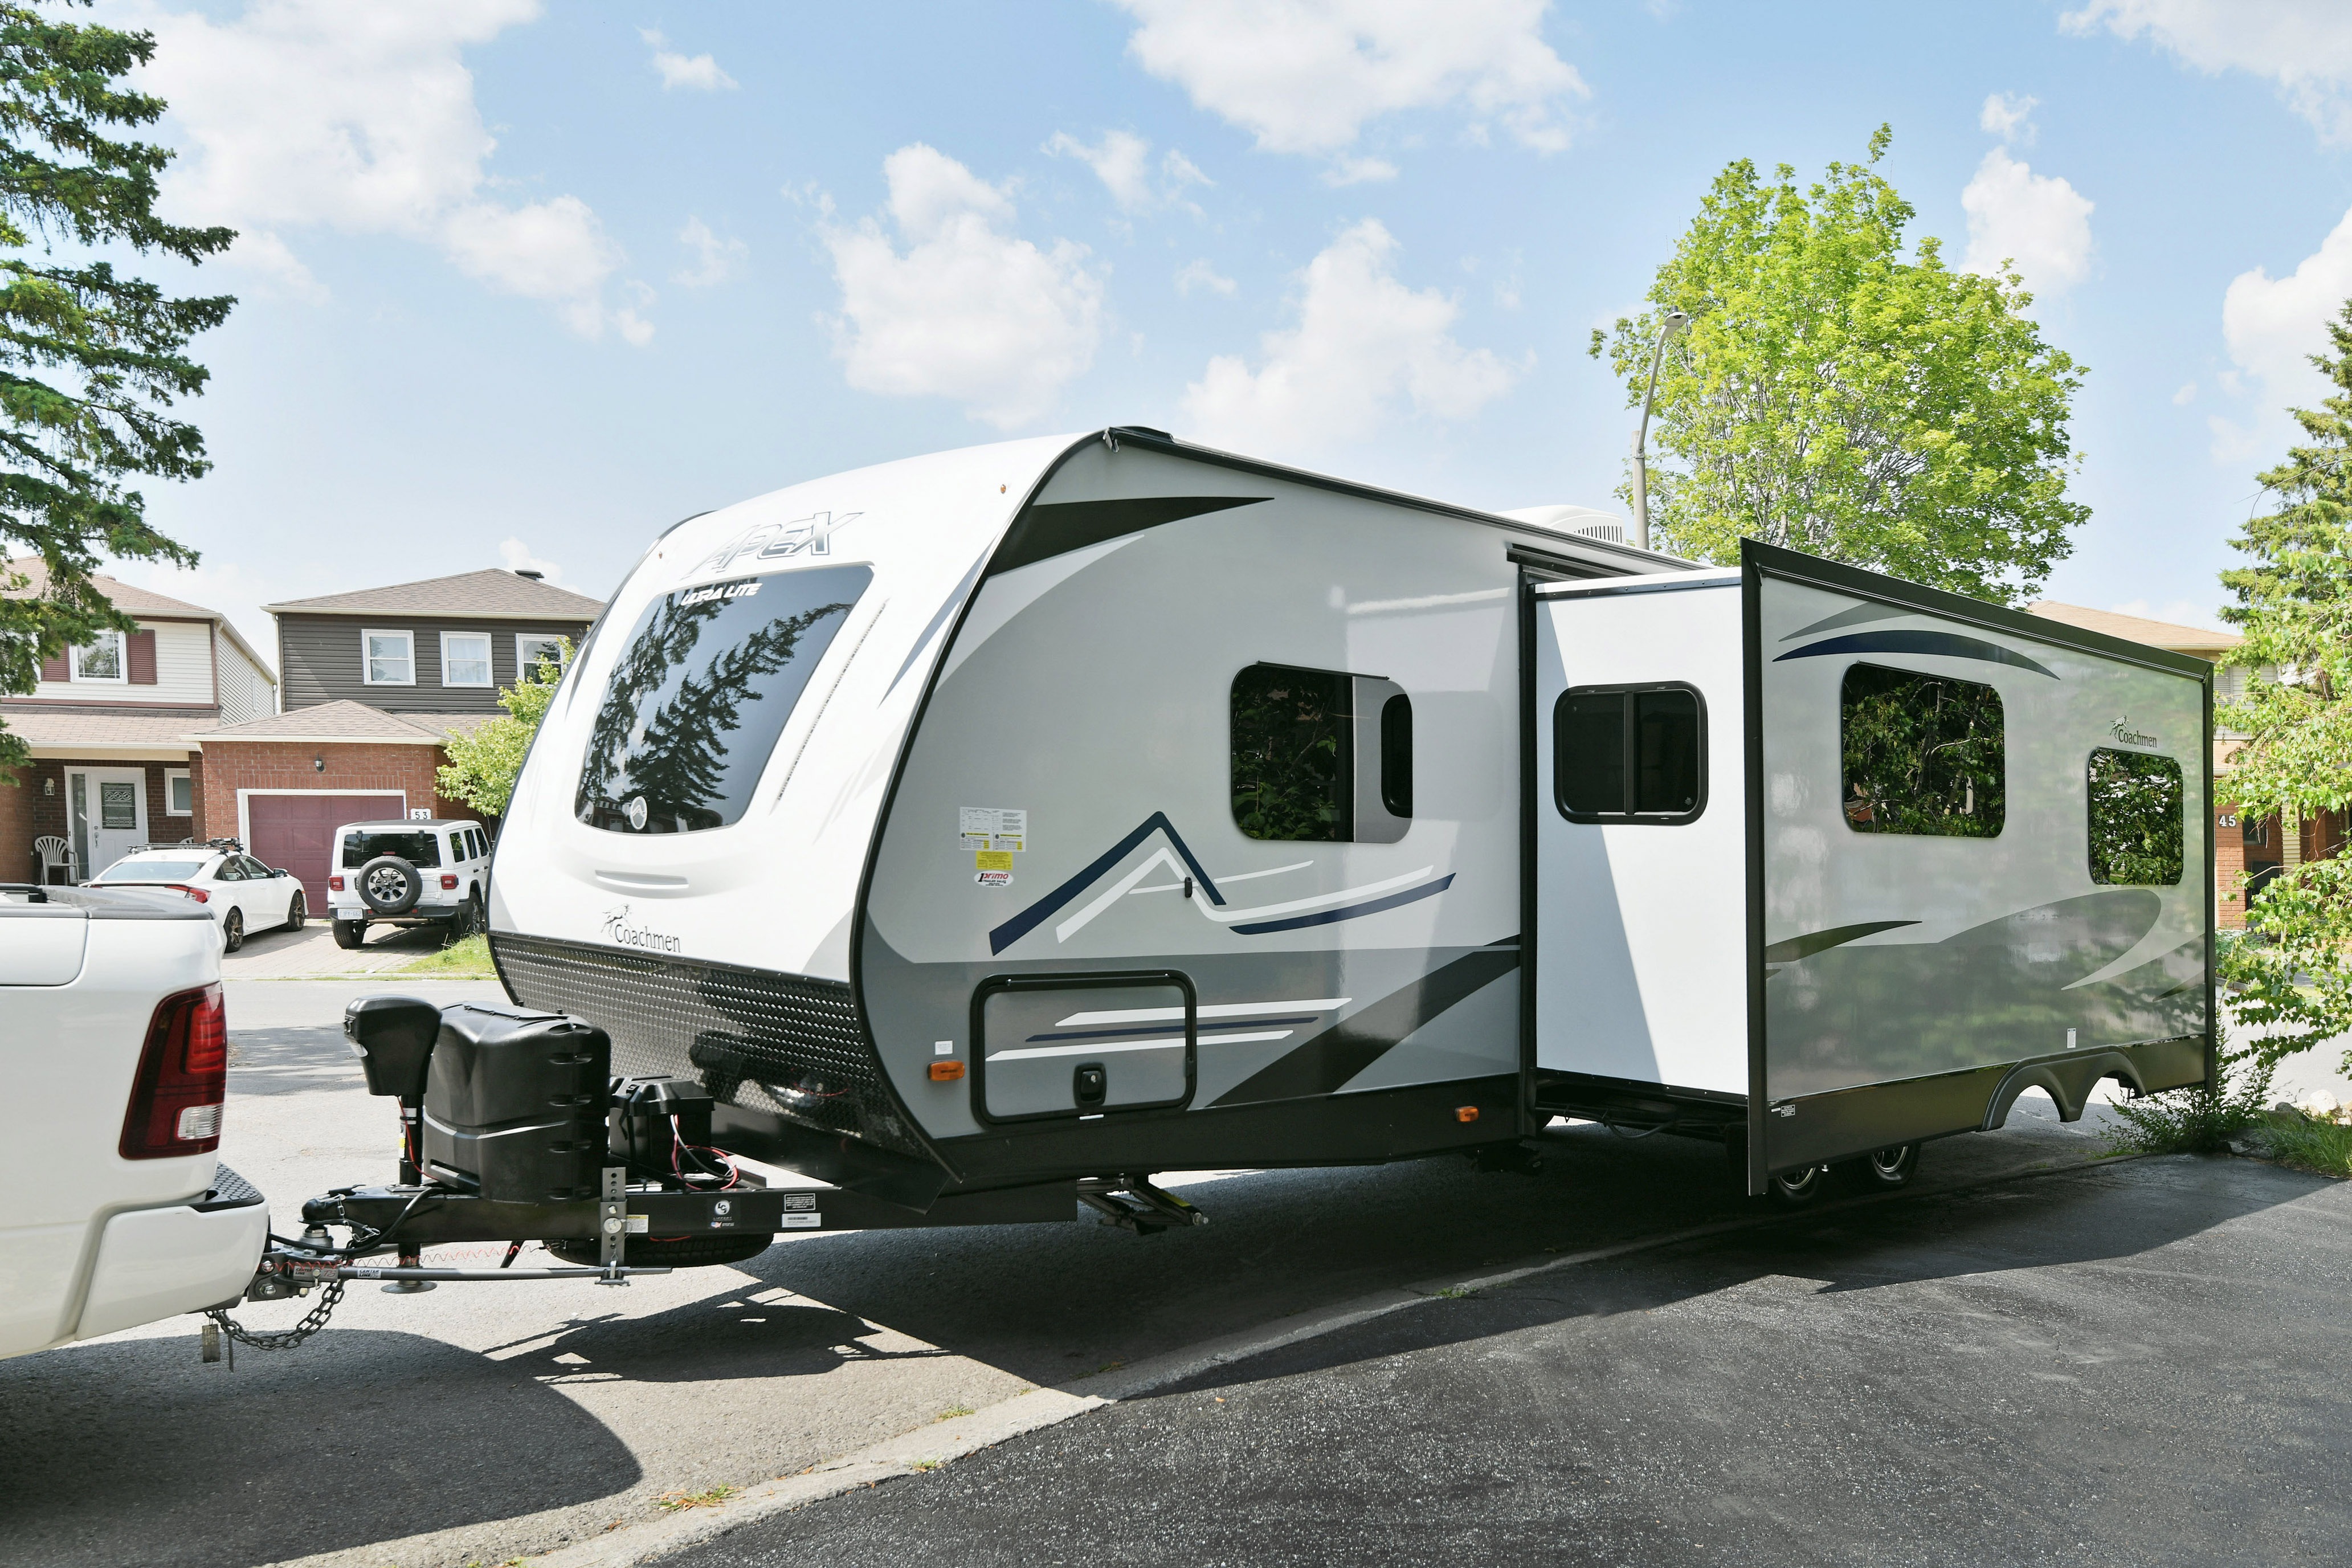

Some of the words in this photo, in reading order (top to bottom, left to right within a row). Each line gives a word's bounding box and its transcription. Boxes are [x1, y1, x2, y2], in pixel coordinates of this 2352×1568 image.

[680, 511, 865, 580] APEX
[680, 587, 724, 606] ULTRA
[723, 583, 762, 598] LITE
[2118, 729, 2157, 748] Coachmen
[2219, 815, 2236, 827] 45
[614, 923, 681, 953] Coachmen
